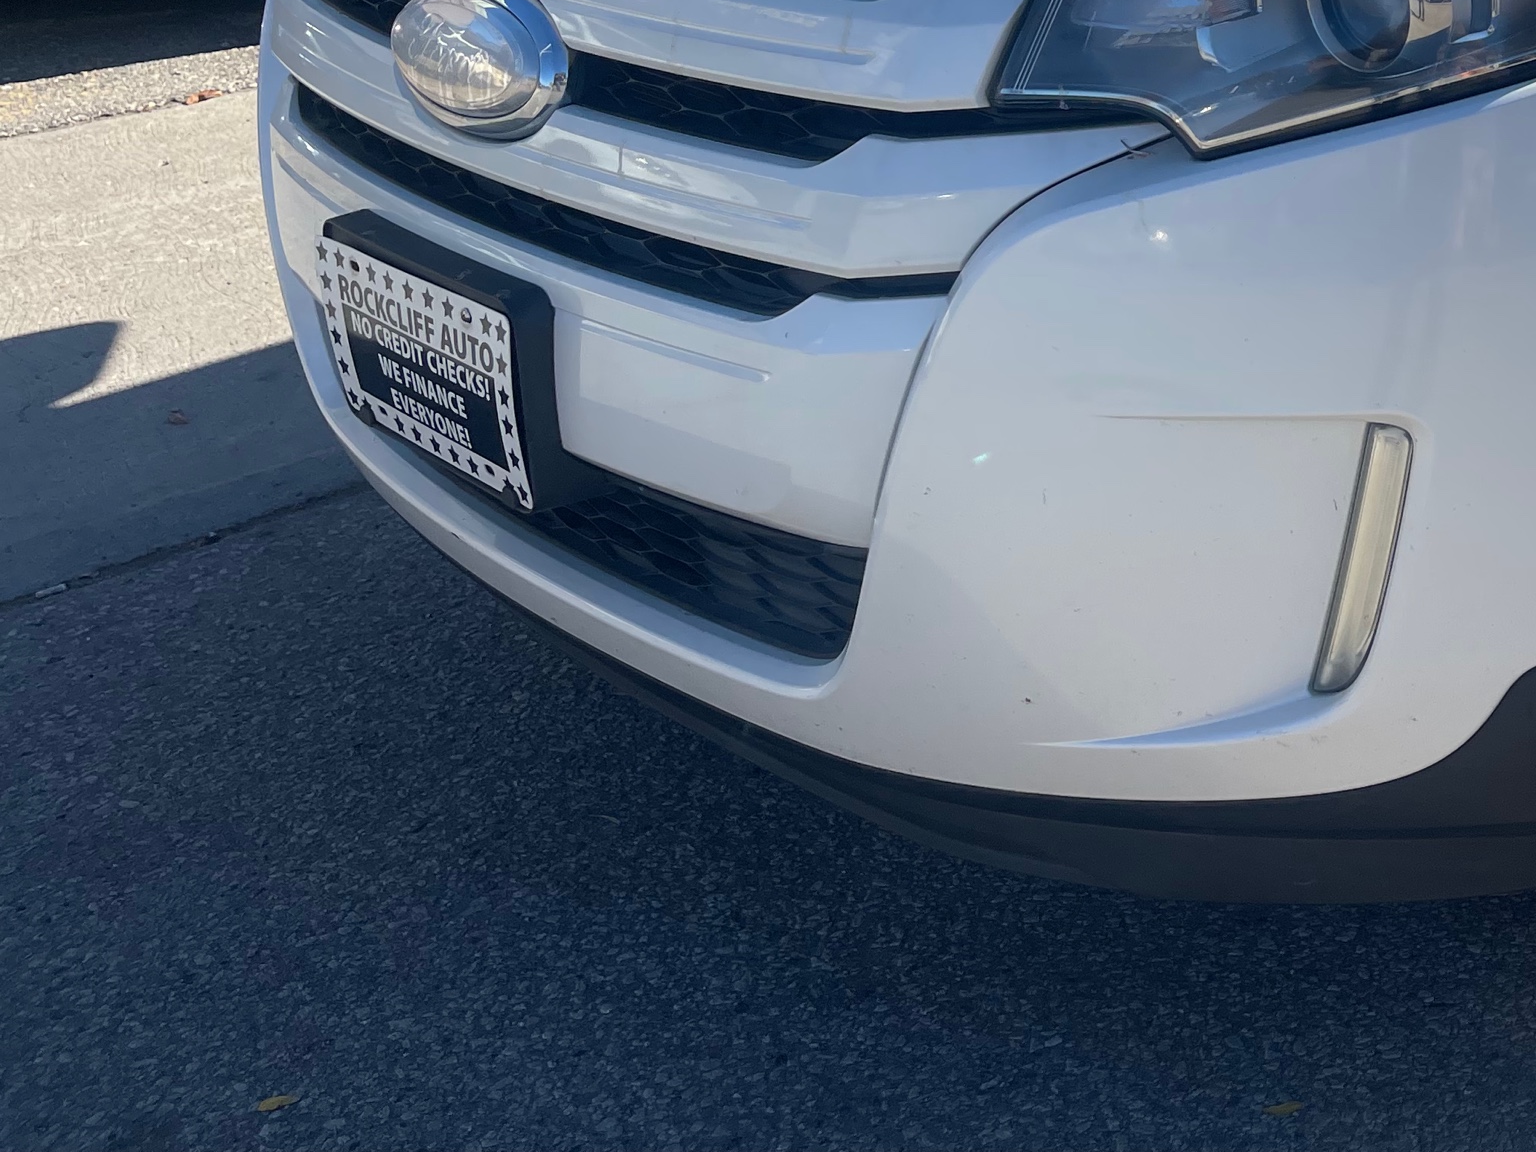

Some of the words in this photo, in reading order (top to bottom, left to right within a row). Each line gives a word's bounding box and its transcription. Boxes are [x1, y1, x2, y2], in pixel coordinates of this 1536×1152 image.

[338, 274, 434, 343] ROCKCLIFF
[441, 323, 494, 373] AUTO
[350, 310, 372, 339] NO
[375, 325, 424, 367] CREDIT
[426, 349, 491, 401] CHECKS!
[377, 352, 402, 384] WE
[403, 369, 468, 419] FINANCE
[390, 387, 472, 449] EVERYONE!
